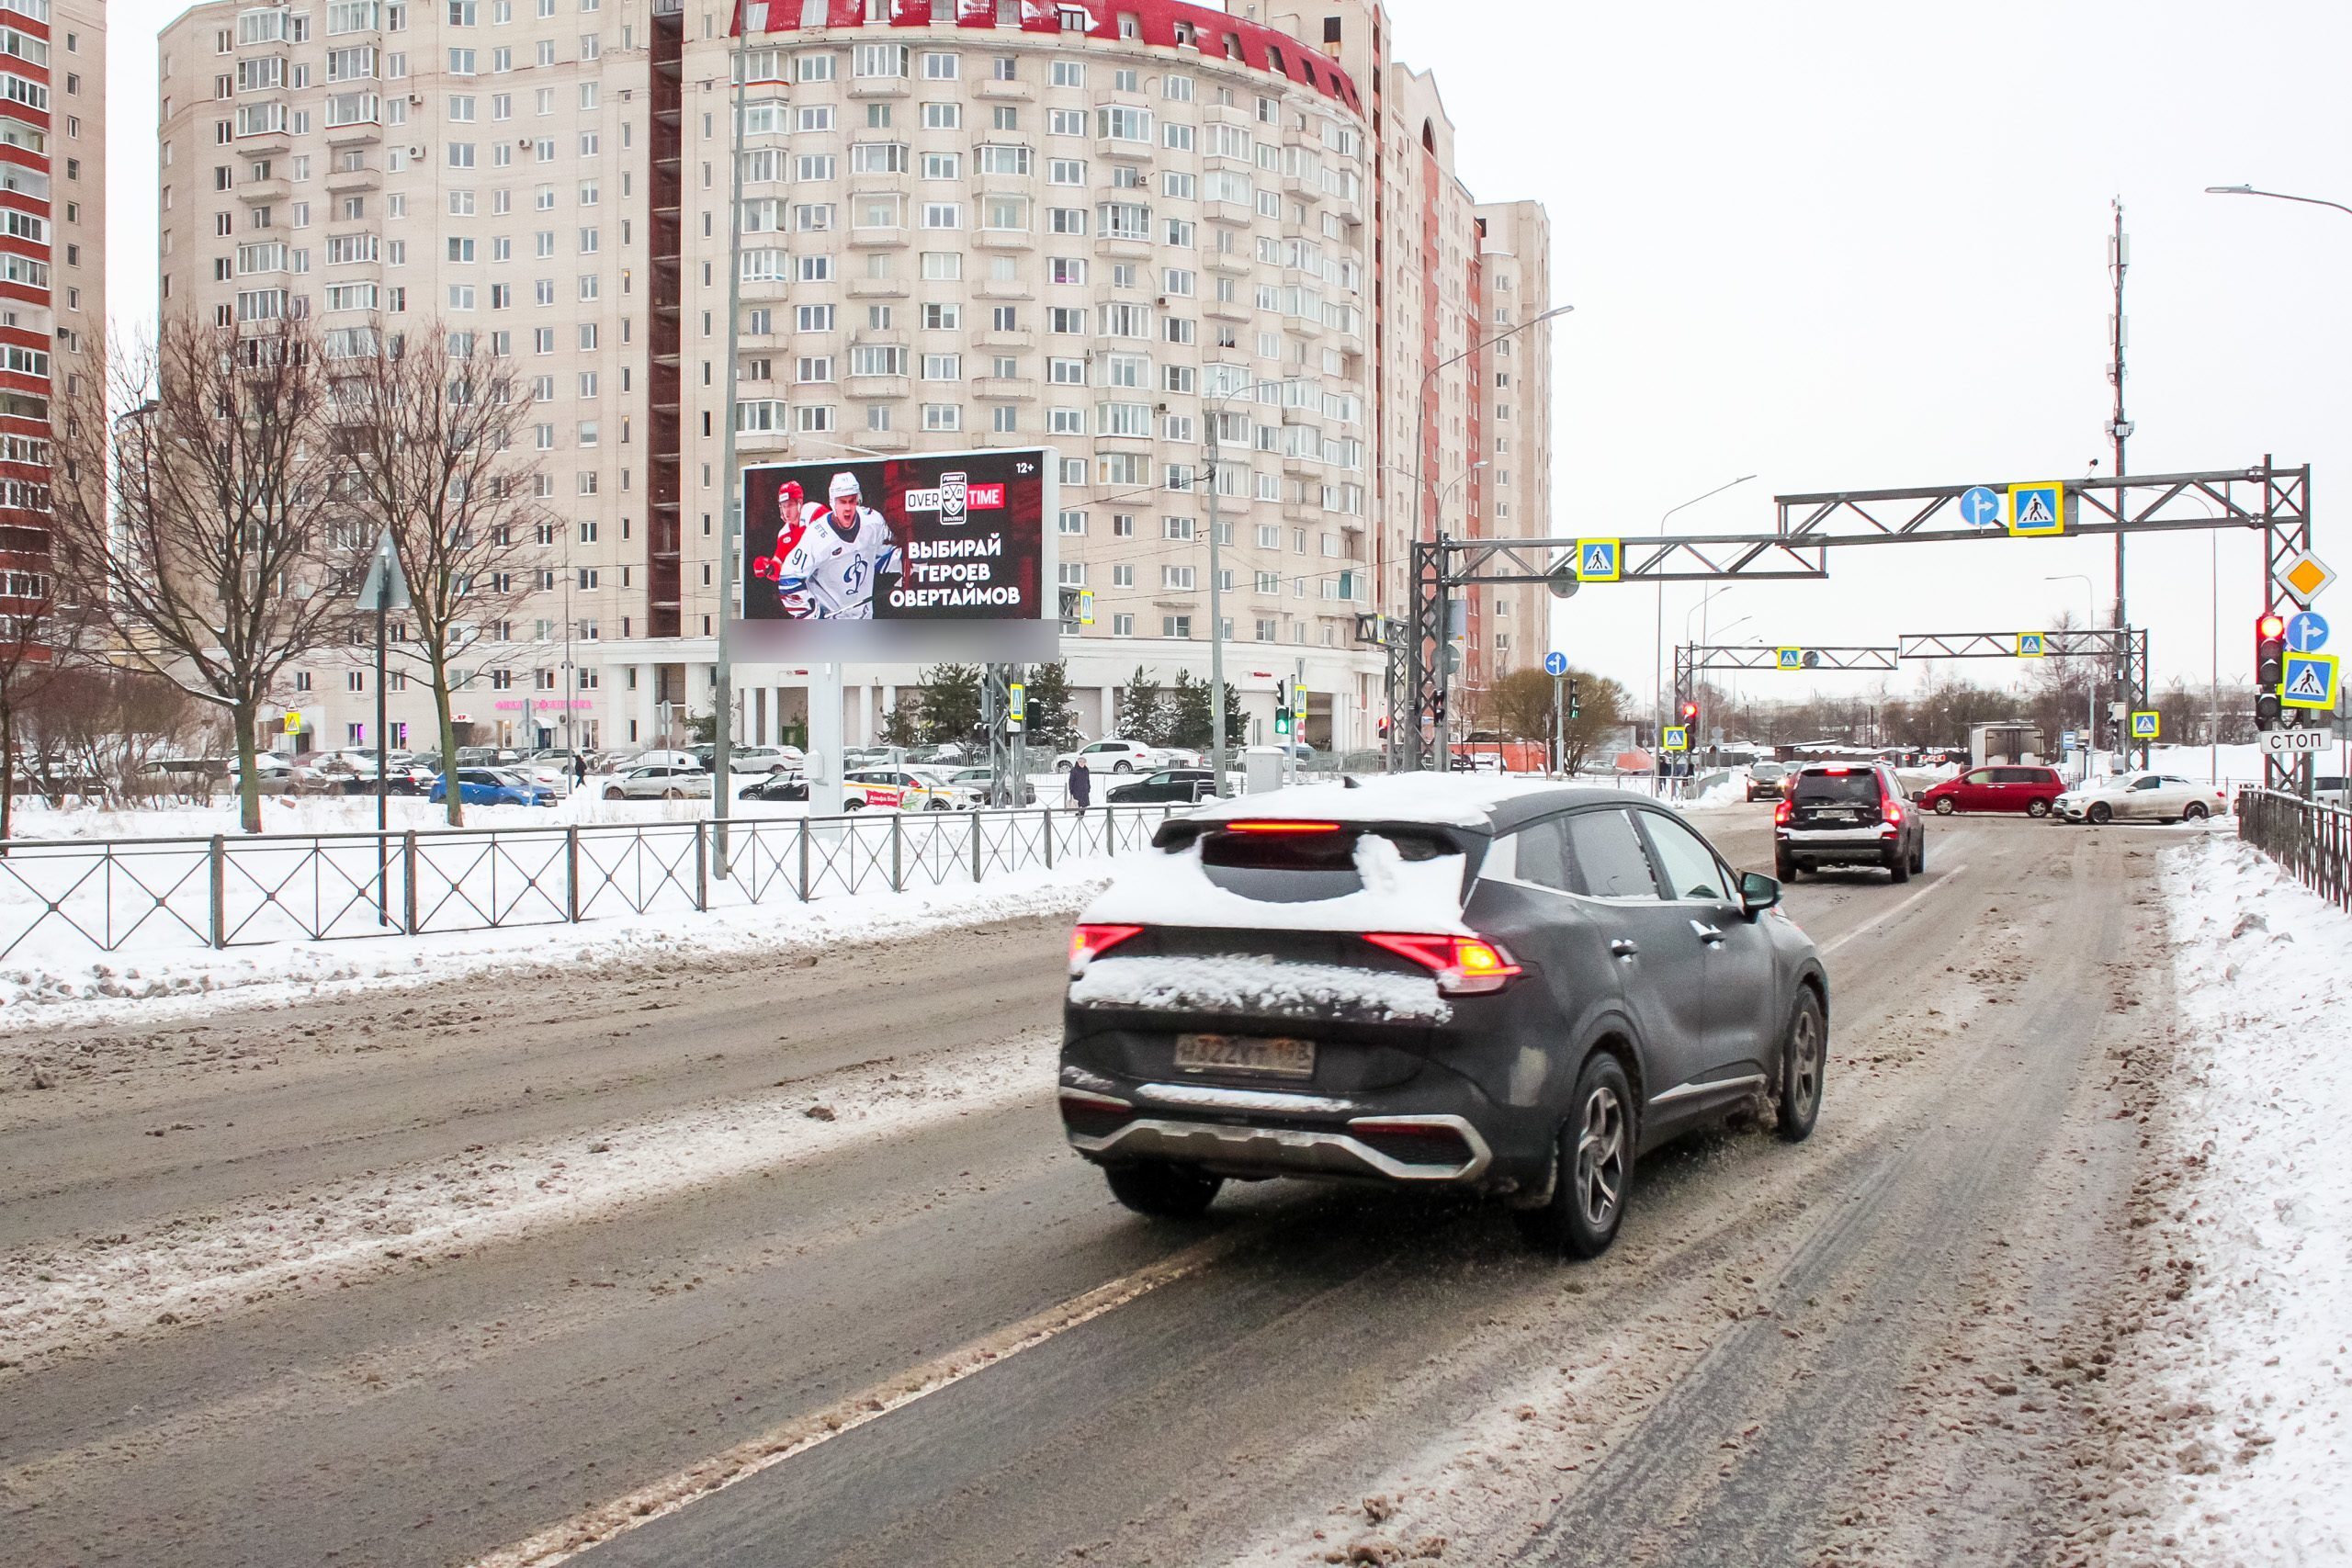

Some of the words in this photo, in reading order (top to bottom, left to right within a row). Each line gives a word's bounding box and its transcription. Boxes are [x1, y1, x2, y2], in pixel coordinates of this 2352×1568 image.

[1016, 463, 1034, 473] 12+
[908, 492, 939, 507] OVER
[968, 489, 1000, 505] TIME
[908, 533, 1001, 559] ВЫБИРАЙ
[792, 548, 808, 570] 91
[919, 563, 990, 582] ГЕРОЕВ
[889, 582, 1021, 607] ОВЕРТАЙМОВ
[2270, 733, 2321, 749] СТОП
